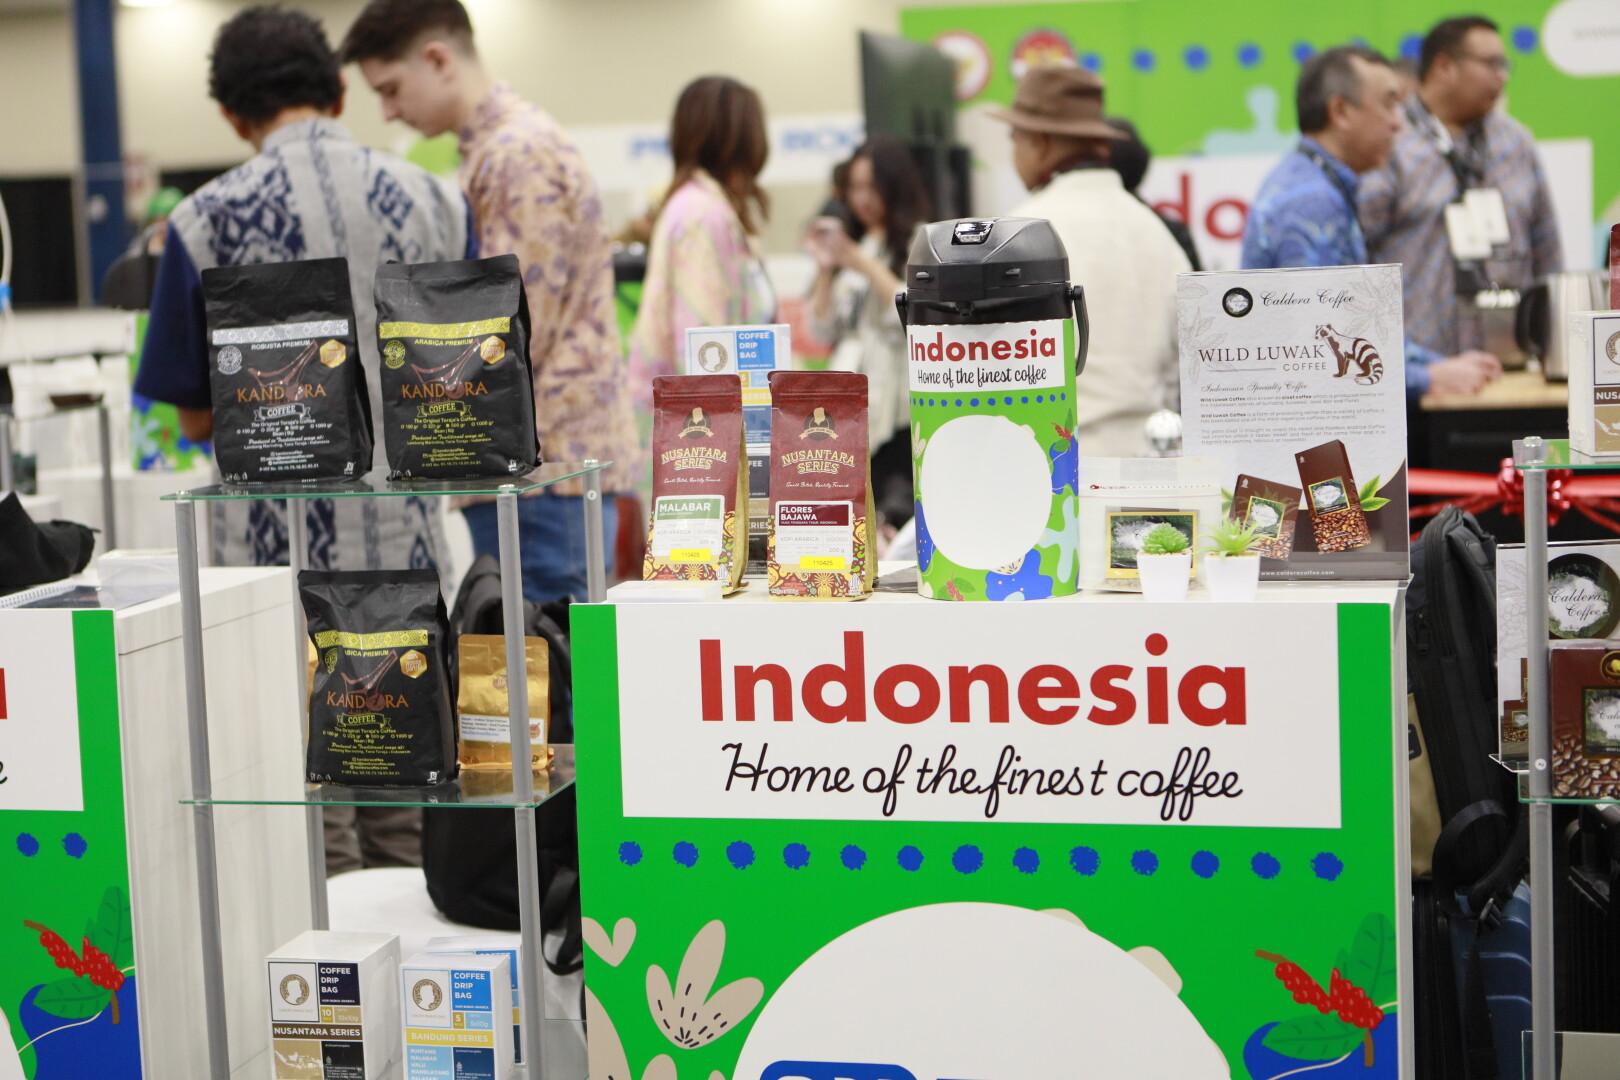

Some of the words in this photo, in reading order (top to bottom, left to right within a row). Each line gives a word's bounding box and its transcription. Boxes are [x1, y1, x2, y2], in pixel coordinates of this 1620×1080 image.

[1261, 291, 1311, 307] Caldera
[1317, 288, 1355, 308] Coffee
[251, 343, 281, 351] ROBUSTA
[282, 340, 311, 349] PREMIUM
[415, 338, 444, 346] ARABICA
[445, 338, 474, 346] PREMIUM
[910, 328, 1056, 362] Indonesia
[1199, 347, 1250, 363] WILD
[1257, 344, 1326, 361] LUWAK
[1283, 362, 1327, 371] COFFEE
[917, 369, 941, 385] Home
[942, 368, 954, 388] of
[956, 368, 974, 384] the
[977, 366, 1012, 388] finest
[1015, 364, 1047, 385] coffee
[267, 405, 296, 417] COFFEE
[429, 403, 456, 414] COFFEE
[661, 447, 728, 464] NUSANTARA
[781, 449, 855, 467] NUSANTARA
[674, 458, 713, 471] SERIES
[797, 461, 840, 474] SERIES
[659, 502, 711, 512] MALABAR
[1550, 586, 1601, 603] Caldera
[1566, 604, 1601, 621] Coffee
[700, 631, 1247, 727] Indonesia
[348, 715, 376, 724] COFFEE
[721, 742, 855, 792] Home
[862, 743, 912, 817] of
[916, 744, 981, 794] the
[979, 745, 1108, 818] finest
[1117, 746, 1244, 822] coffee
[320, 967, 351, 975] COFFEE
[454, 972, 485, 980] COFFEE
[322, 1009, 331, 1017] 10
[455, 1014, 461, 1022] 5
[274, 1027, 328, 1036] NUSANTARA
[331, 1028, 361, 1037] SERIES
[411, 1032, 455, 1042] BANDUNG
[458, 1034, 489, 1042] SERIES
